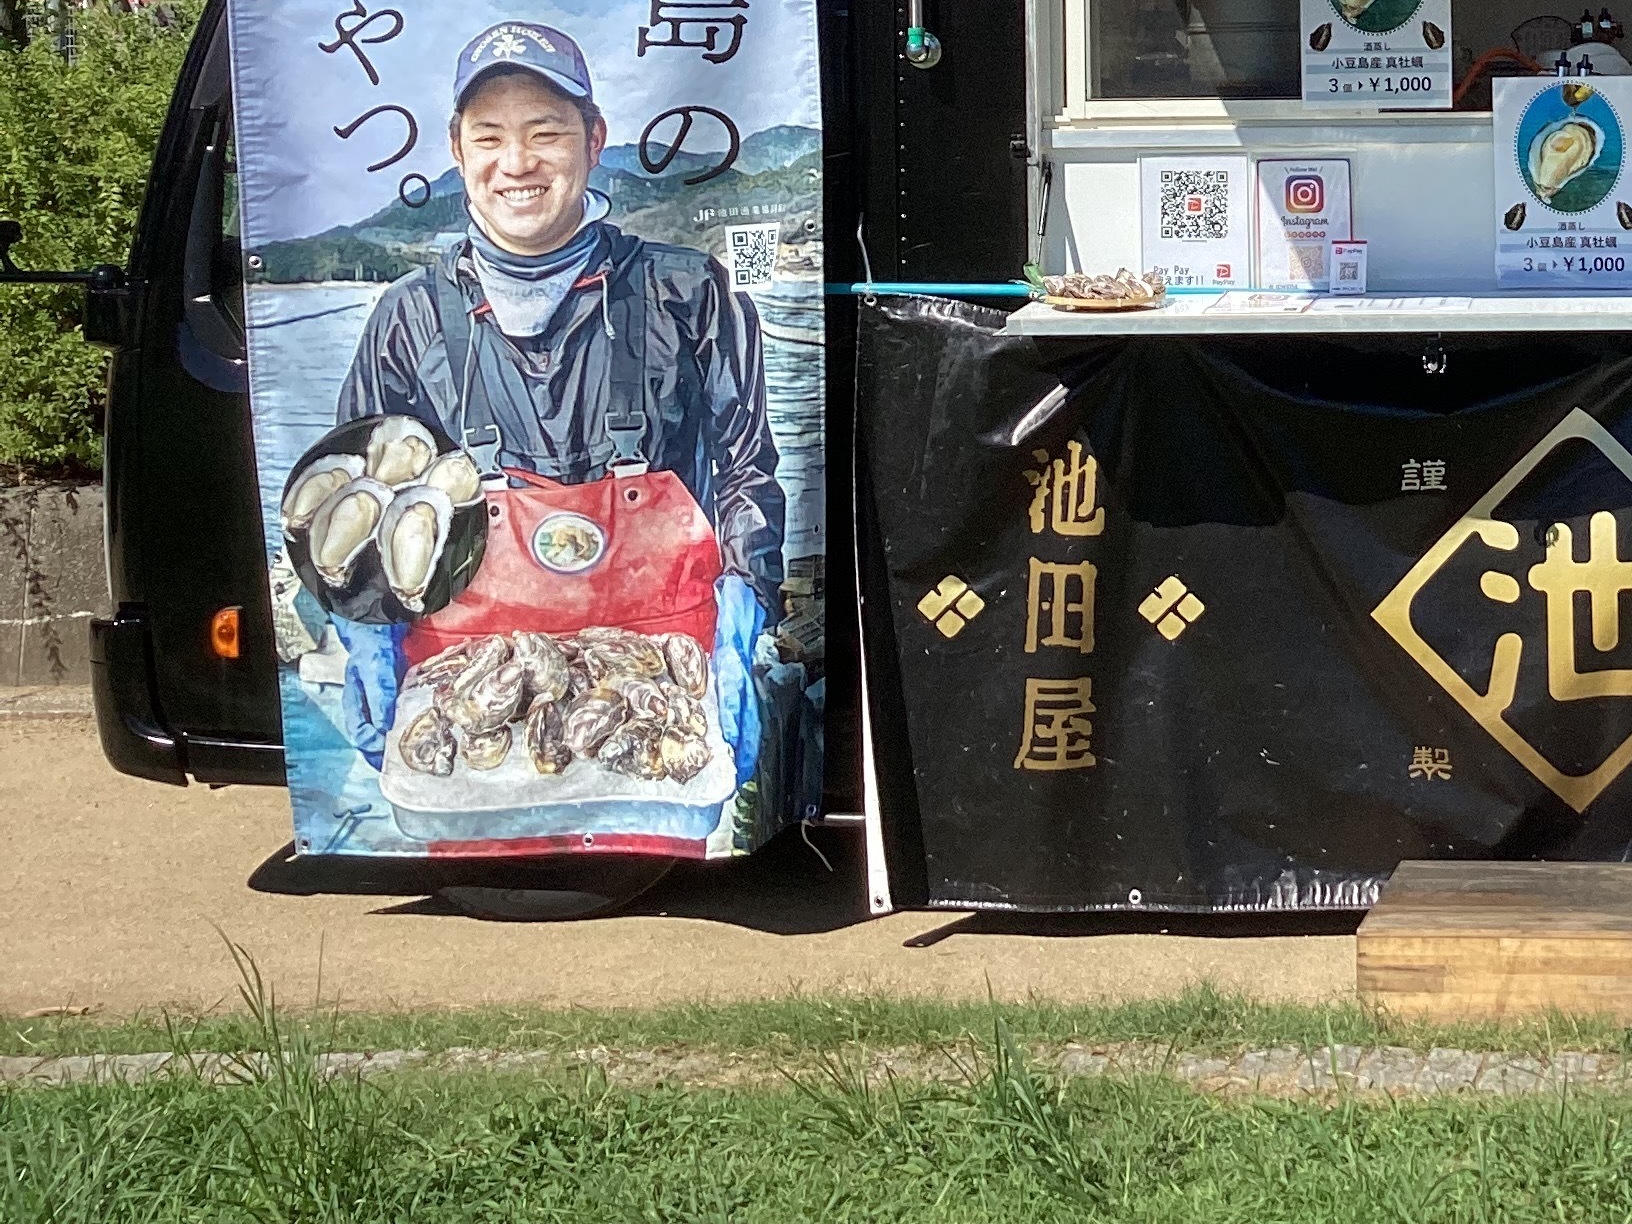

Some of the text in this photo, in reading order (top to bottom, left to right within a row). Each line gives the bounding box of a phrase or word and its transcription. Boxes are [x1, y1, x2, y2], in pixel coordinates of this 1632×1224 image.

[1331, 55, 1424, 69] 小豆島産 真牡蠣
[1280, 216, 1329, 229] Instagram
[1526, 236, 1577, 249] 小豆島産
[1154, 265, 1190, 276] Pay Pay
[1013, 440, 1105, 772] 池田屋
